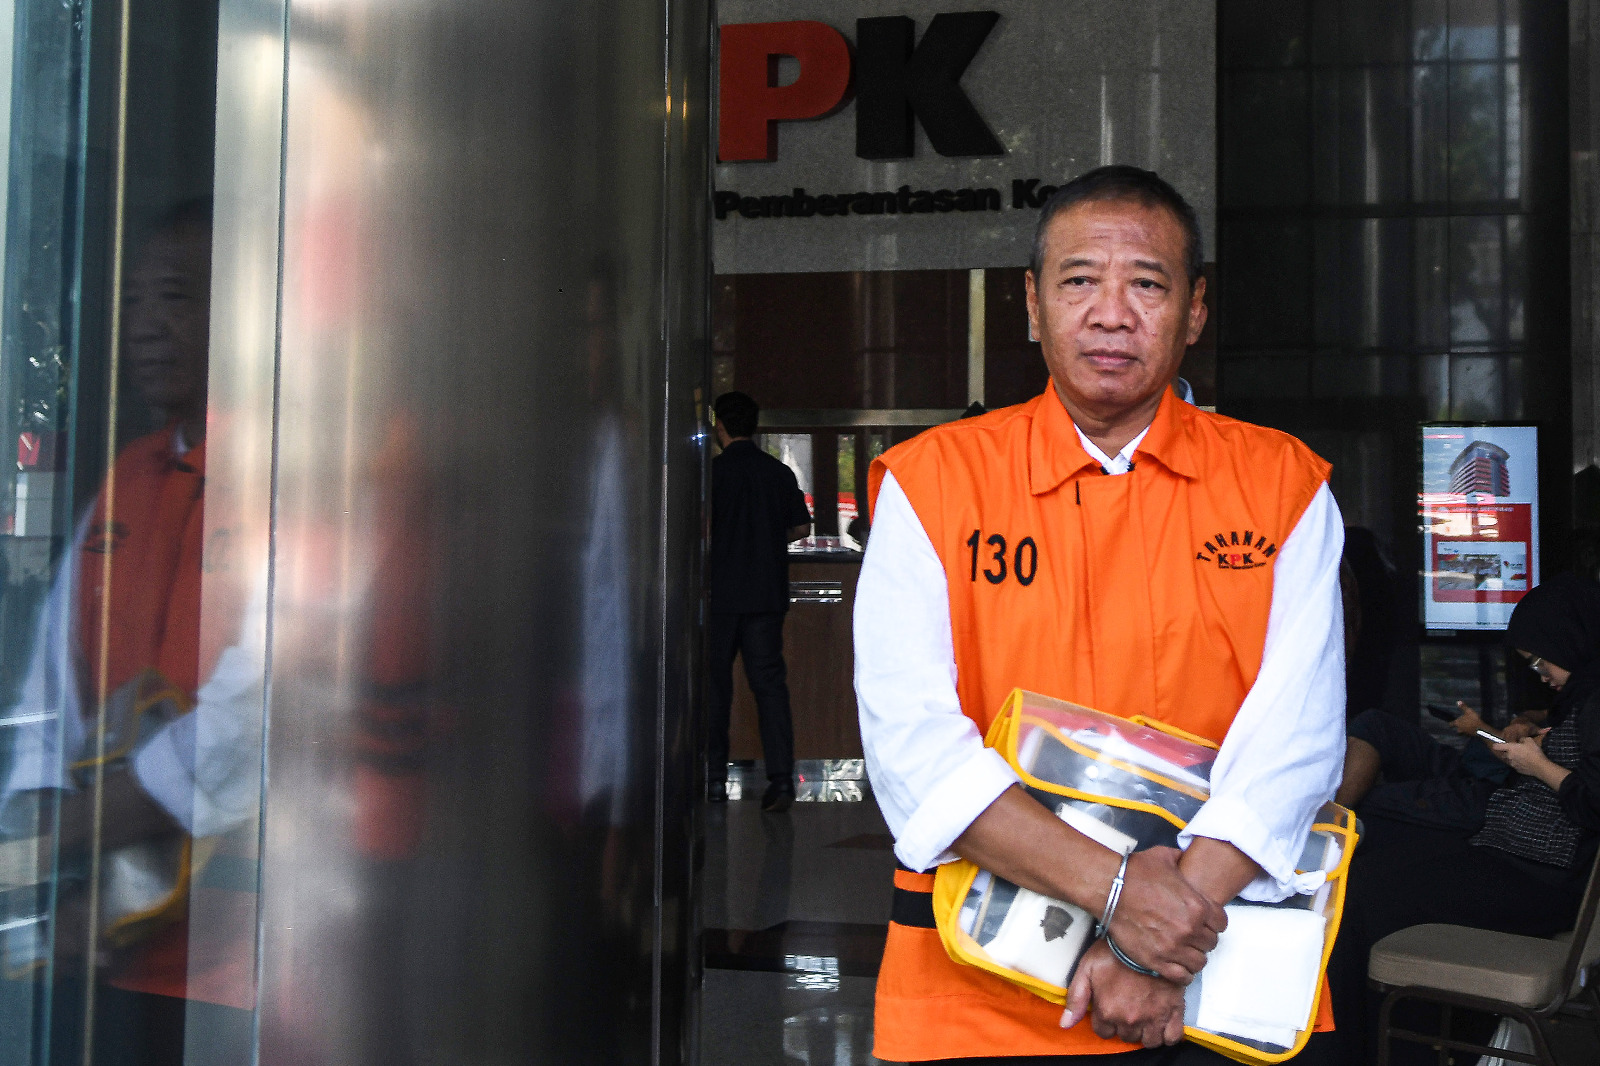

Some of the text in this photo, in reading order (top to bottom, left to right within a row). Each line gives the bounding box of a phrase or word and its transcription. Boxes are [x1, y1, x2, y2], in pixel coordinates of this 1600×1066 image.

[716, 11, 1005, 162] PK
[715, 178, 1060, 219] Pemberantasan Ko
[967, 529, 1038, 586] 130
[1196, 530, 1277, 561] TAHANAN
[1218, 553, 1254, 565] KPK
